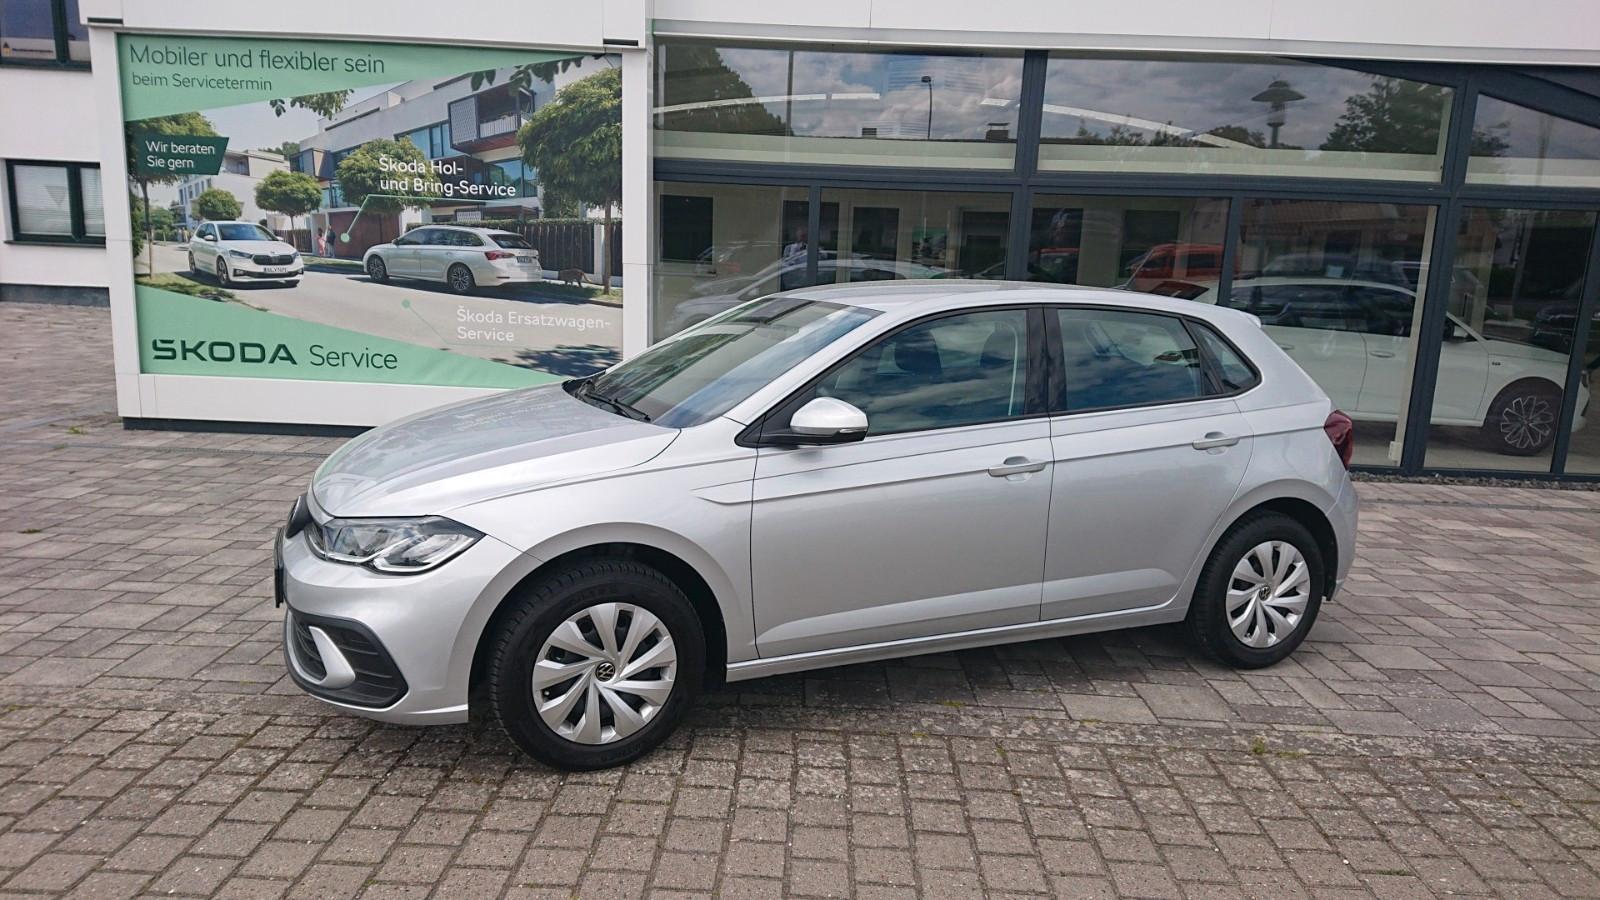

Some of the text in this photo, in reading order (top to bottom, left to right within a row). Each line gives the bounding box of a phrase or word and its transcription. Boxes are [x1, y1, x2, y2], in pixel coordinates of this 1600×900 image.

[129, 44, 385, 74] Mobiler und flexibler sein
[132, 72, 272, 92] beim Servicetermin
[145, 140, 216, 156] Wir beraten
[146, 155, 194, 171] Sie gern
[379, 154, 464, 174] Škoda Hol-
[380, 178, 516, 197] und Bring-Service
[456, 306, 612, 330] Škoda Ersatzwagen-
[456, 326, 515, 342] Service
[310, 344, 398, 370] Service
